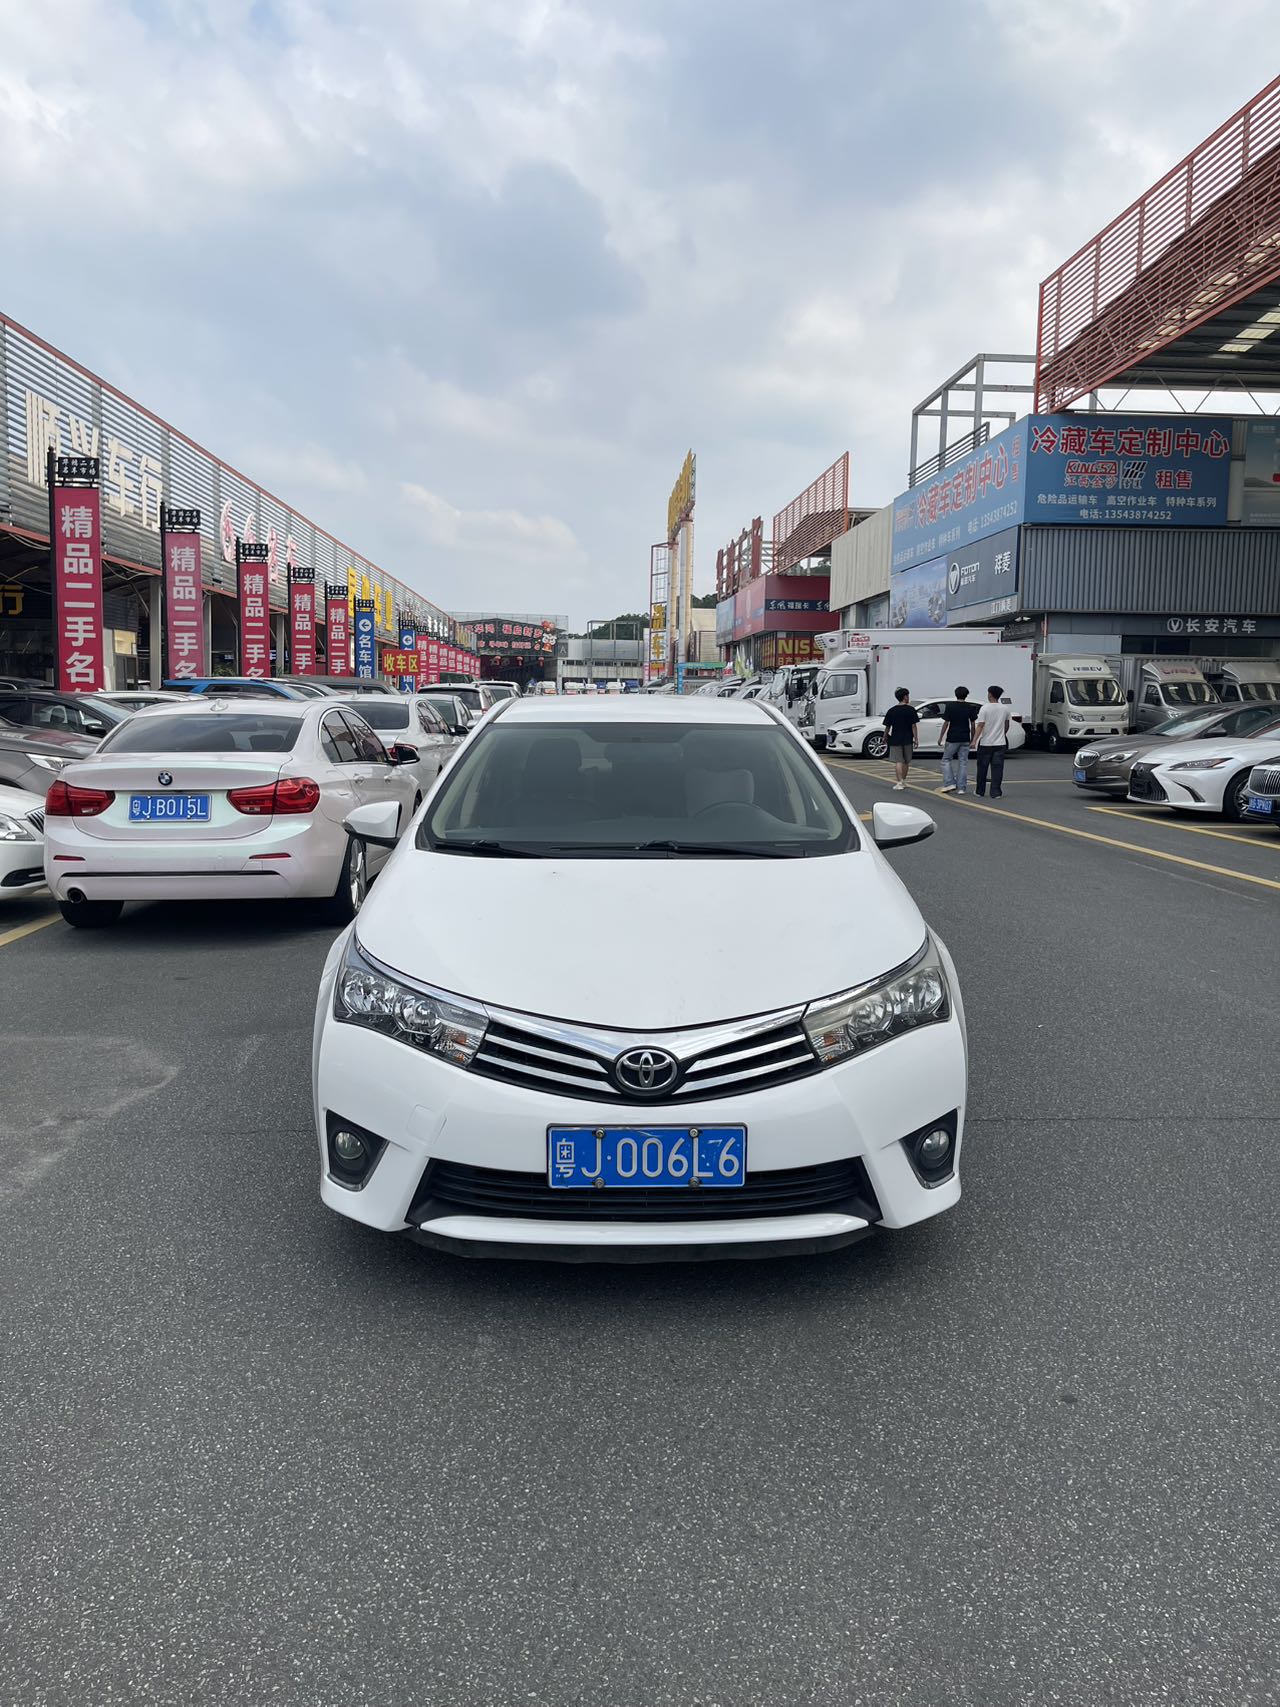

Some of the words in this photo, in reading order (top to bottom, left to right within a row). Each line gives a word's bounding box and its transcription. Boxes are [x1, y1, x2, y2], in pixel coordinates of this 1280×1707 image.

[1031, 425, 1229, 459] 冷藏车定制中心
[917, 441, 1008, 528] 冷藏车定制中心
[1156, 470, 1192, 489] 租售
[1037, 493, 1097, 505] 危险品运输车
[1106, 495, 1157, 506] 高空作业车
[1166, 496, 1217, 508] 特种车系列
[1105, 510, 1171, 520] 13543874252
[61, 505, 96, 693] 精品二手名
[294, 594, 312, 674] 精品二手
[1186, 618, 1257, 634] 长安汽车
[383, 653, 419, 673] 收车区
[555, 1137, 740, 1178] 粤J·006L6
